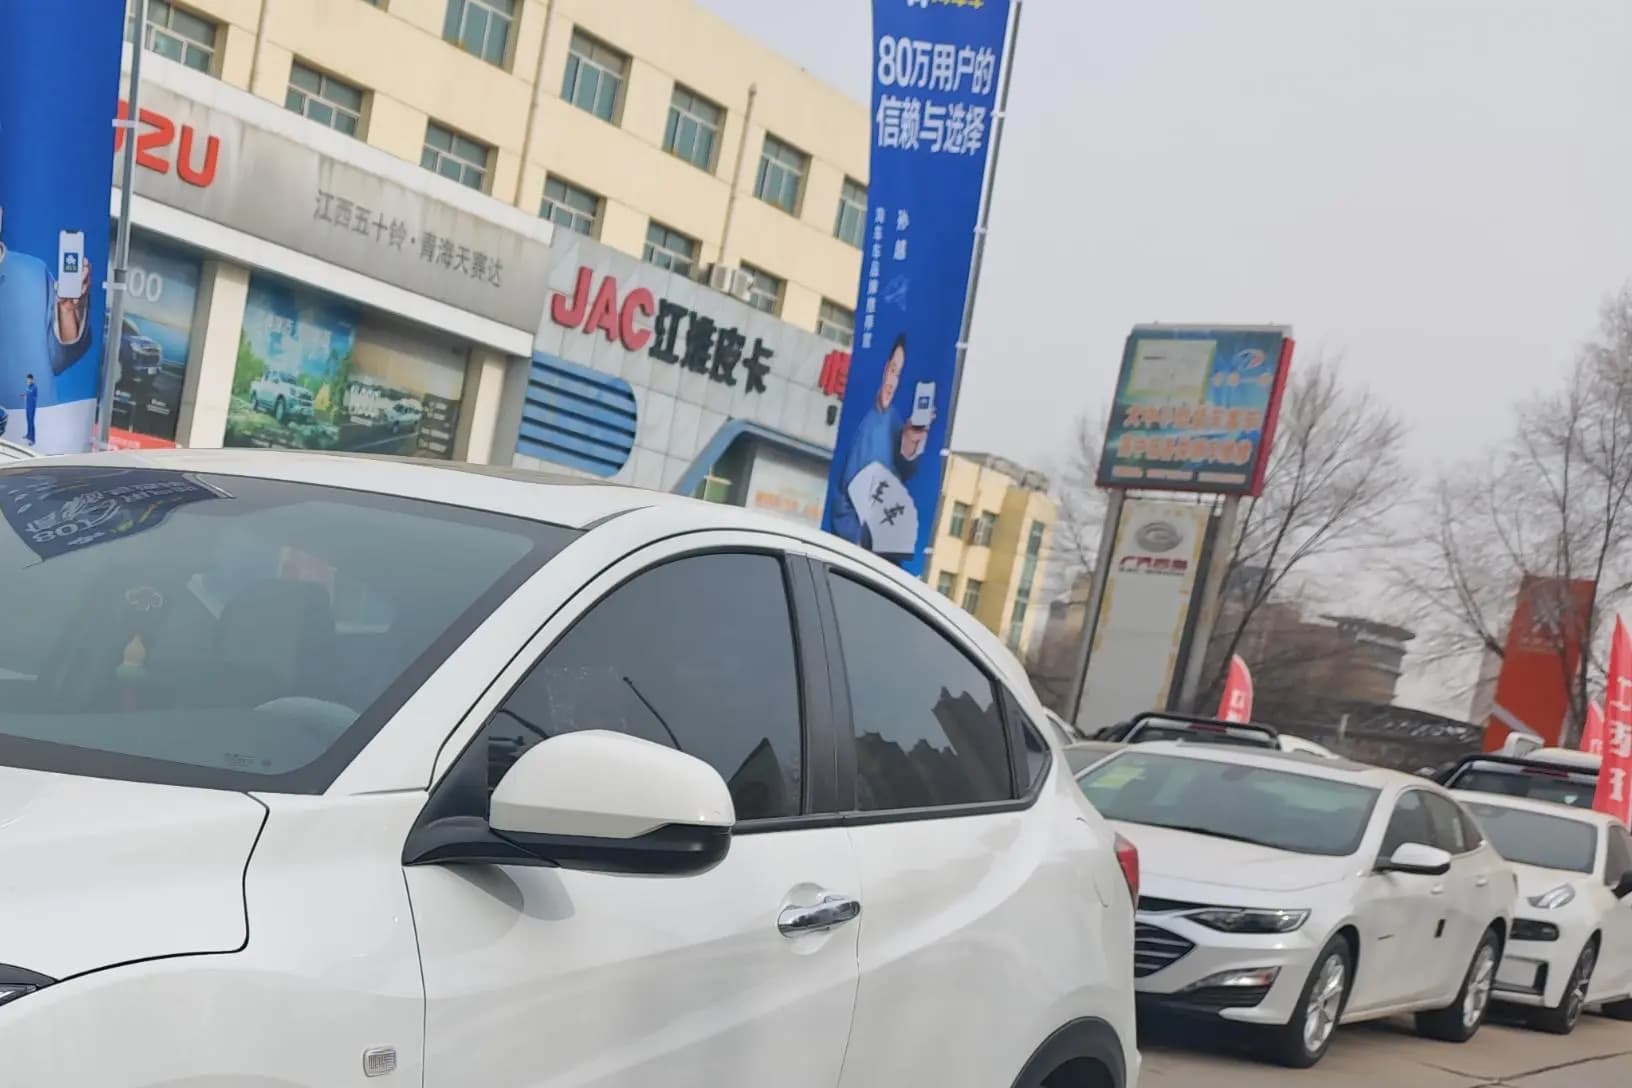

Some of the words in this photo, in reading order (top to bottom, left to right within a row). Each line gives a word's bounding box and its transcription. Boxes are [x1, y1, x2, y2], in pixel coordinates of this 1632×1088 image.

[877, 35, 996, 95] 80万用户的
[876, 94, 986, 156] 信赖与选择
